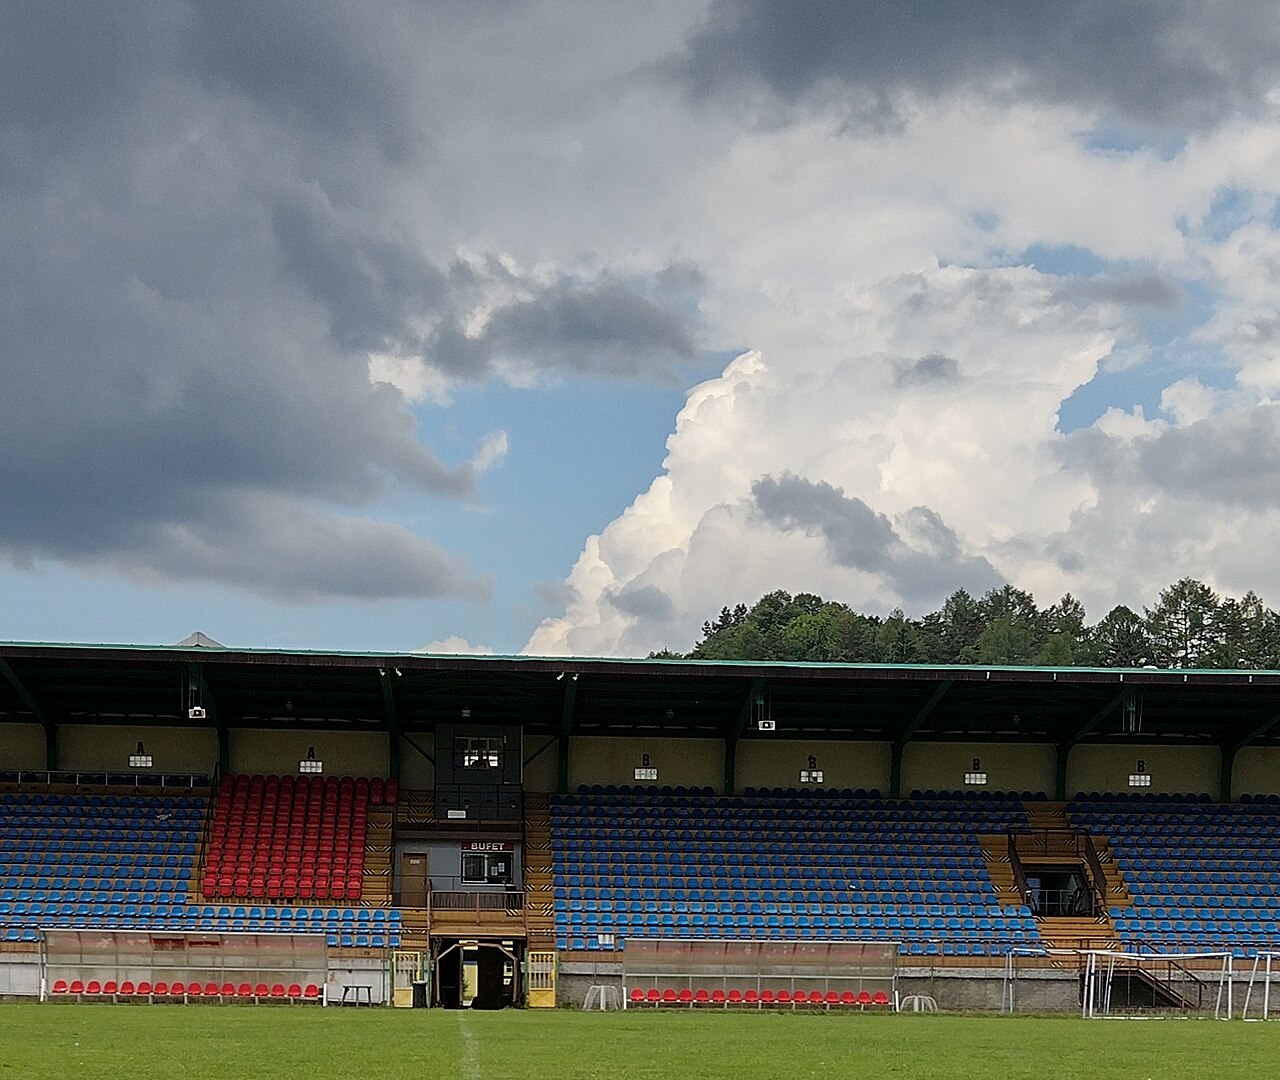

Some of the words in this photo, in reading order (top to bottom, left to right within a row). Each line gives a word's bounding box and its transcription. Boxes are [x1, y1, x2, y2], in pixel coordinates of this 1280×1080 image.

[136, 741, 145, 754] A
[307, 746, 316, 759] A
[642, 753, 650, 766] B
[809, 756, 817, 769] B
[972, 758, 981, 771] B
[1137, 760, 1145, 772] B
[471, 842, 505, 850] BUFET
